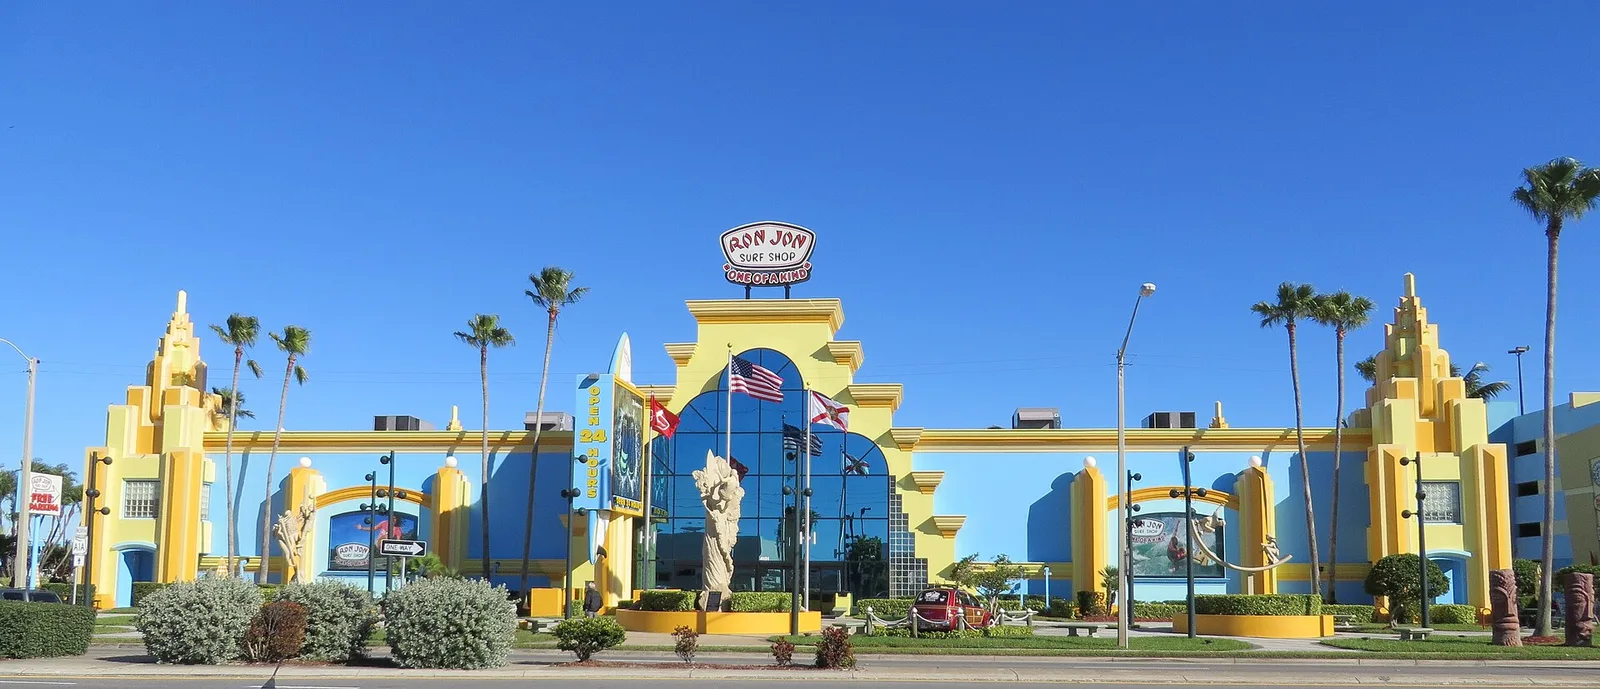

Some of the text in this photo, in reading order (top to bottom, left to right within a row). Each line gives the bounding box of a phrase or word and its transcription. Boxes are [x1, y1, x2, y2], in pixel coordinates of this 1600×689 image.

[729, 229, 807, 253] RON JON
[739, 252, 796, 262] SURF SHOP
[728, 269, 808, 284] ONE OF A KIND
[588, 386, 601, 426] OPEN
[579, 429, 608, 443] 24
[587, 448, 599, 498] HOURS
[31, 493, 54, 503] FREE
[28, 503, 59, 512] PARKING
[1147, 521, 1163, 530] JON
[340, 545, 368, 554] RON JON
